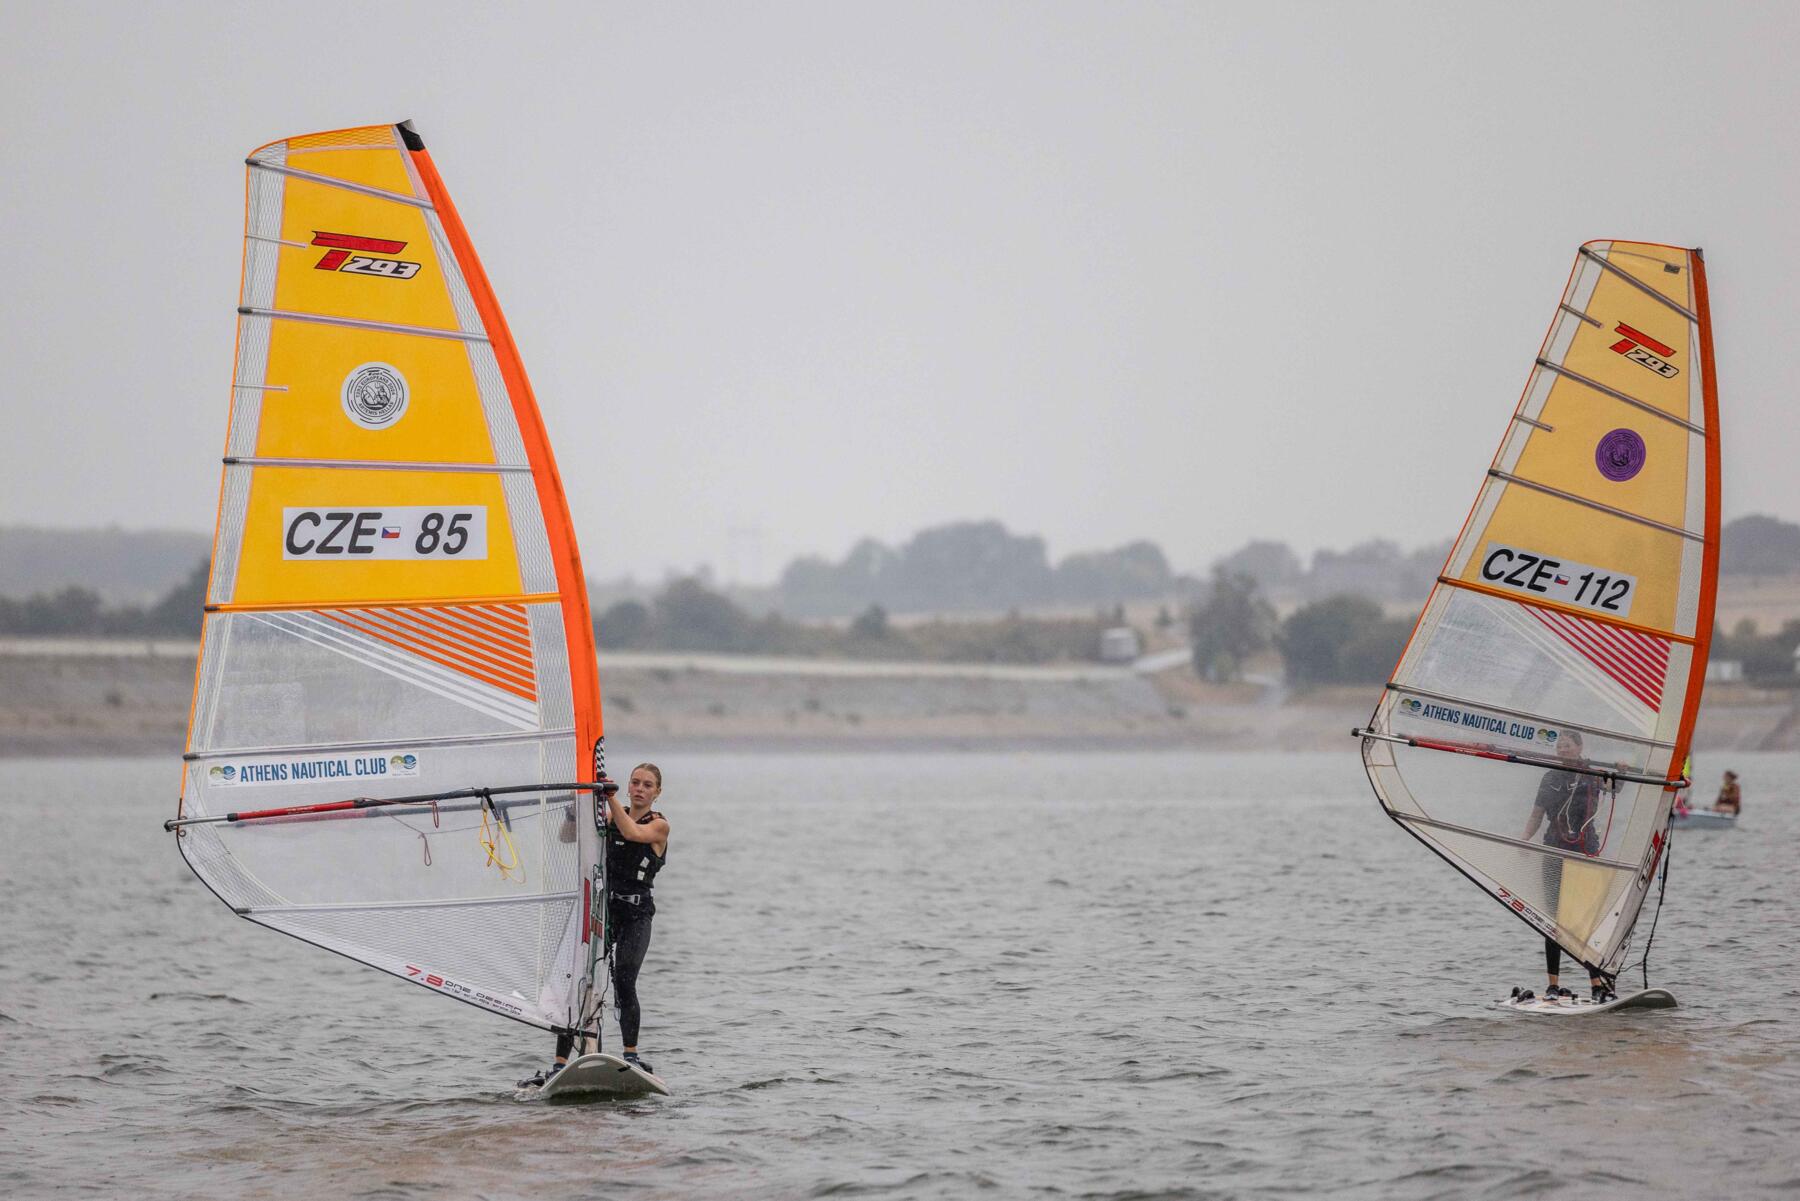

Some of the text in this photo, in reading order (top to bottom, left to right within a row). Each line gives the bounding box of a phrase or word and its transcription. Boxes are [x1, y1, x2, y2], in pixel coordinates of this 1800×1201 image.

[286, 511, 473, 556] CZE 85
[1482, 548, 1630, 611] CZE 112
[1423, 704, 1535, 740] ATHENS NAUTICAL CLUB
[240, 757, 387, 783] ATHENS NAUTICAL CLUB
[406, 965, 444, 987] 7.8
